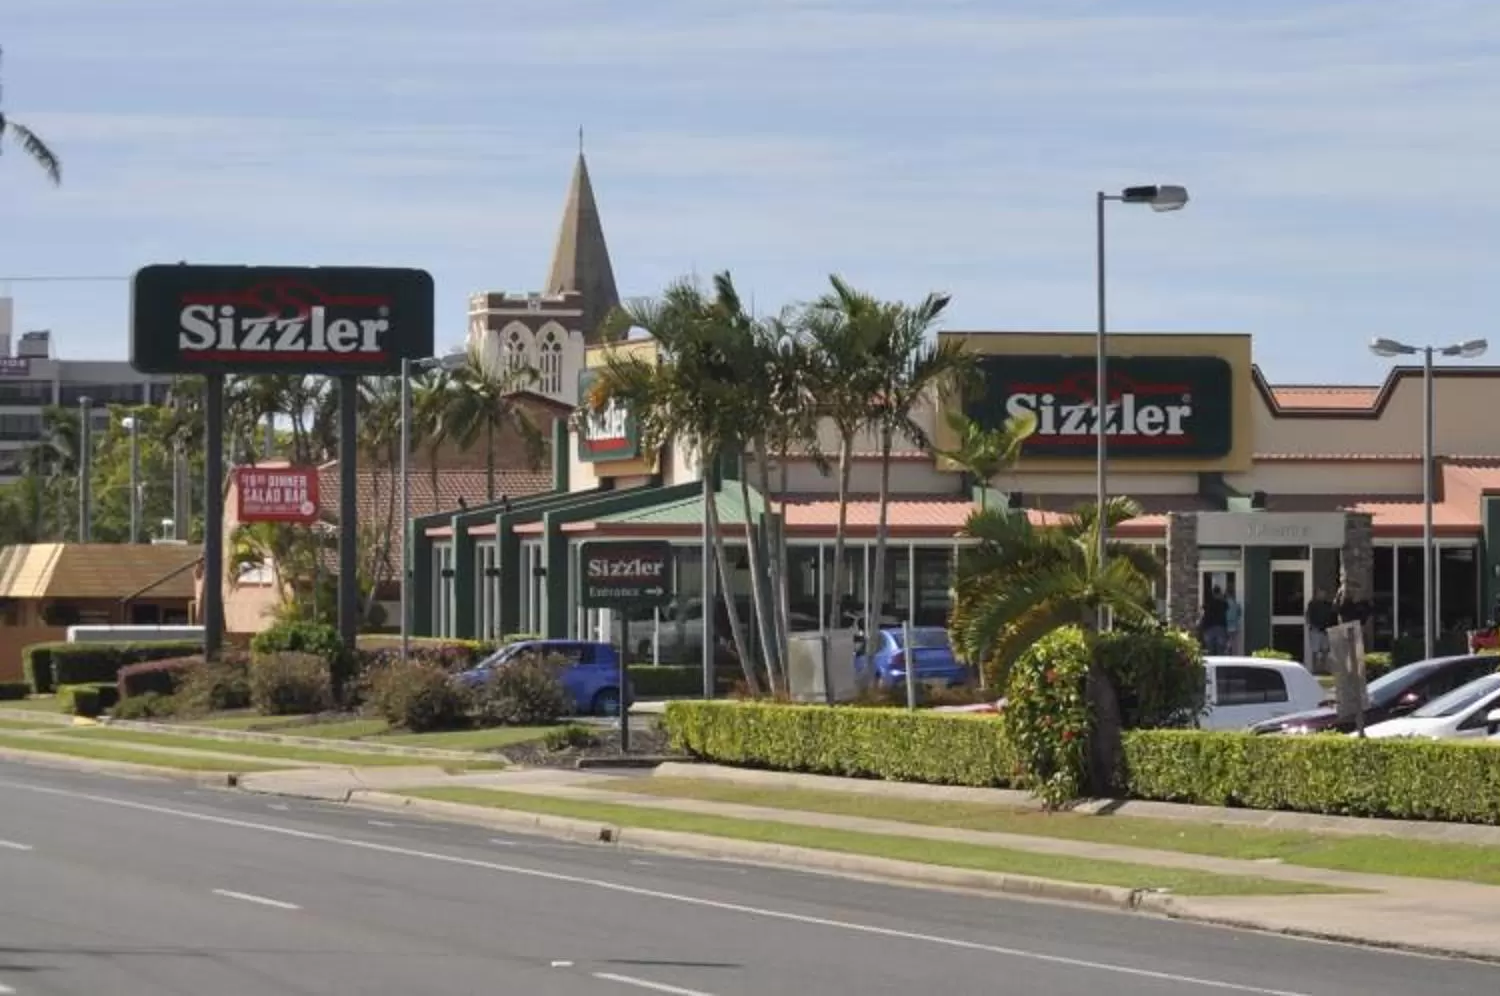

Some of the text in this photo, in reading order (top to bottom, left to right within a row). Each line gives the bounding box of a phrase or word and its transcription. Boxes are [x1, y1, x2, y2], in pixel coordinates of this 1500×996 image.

[179, 305, 389, 352] Sizzler
[1005, 392, 1193, 437] Sizzler
[587, 557, 664, 577] Sizzler
